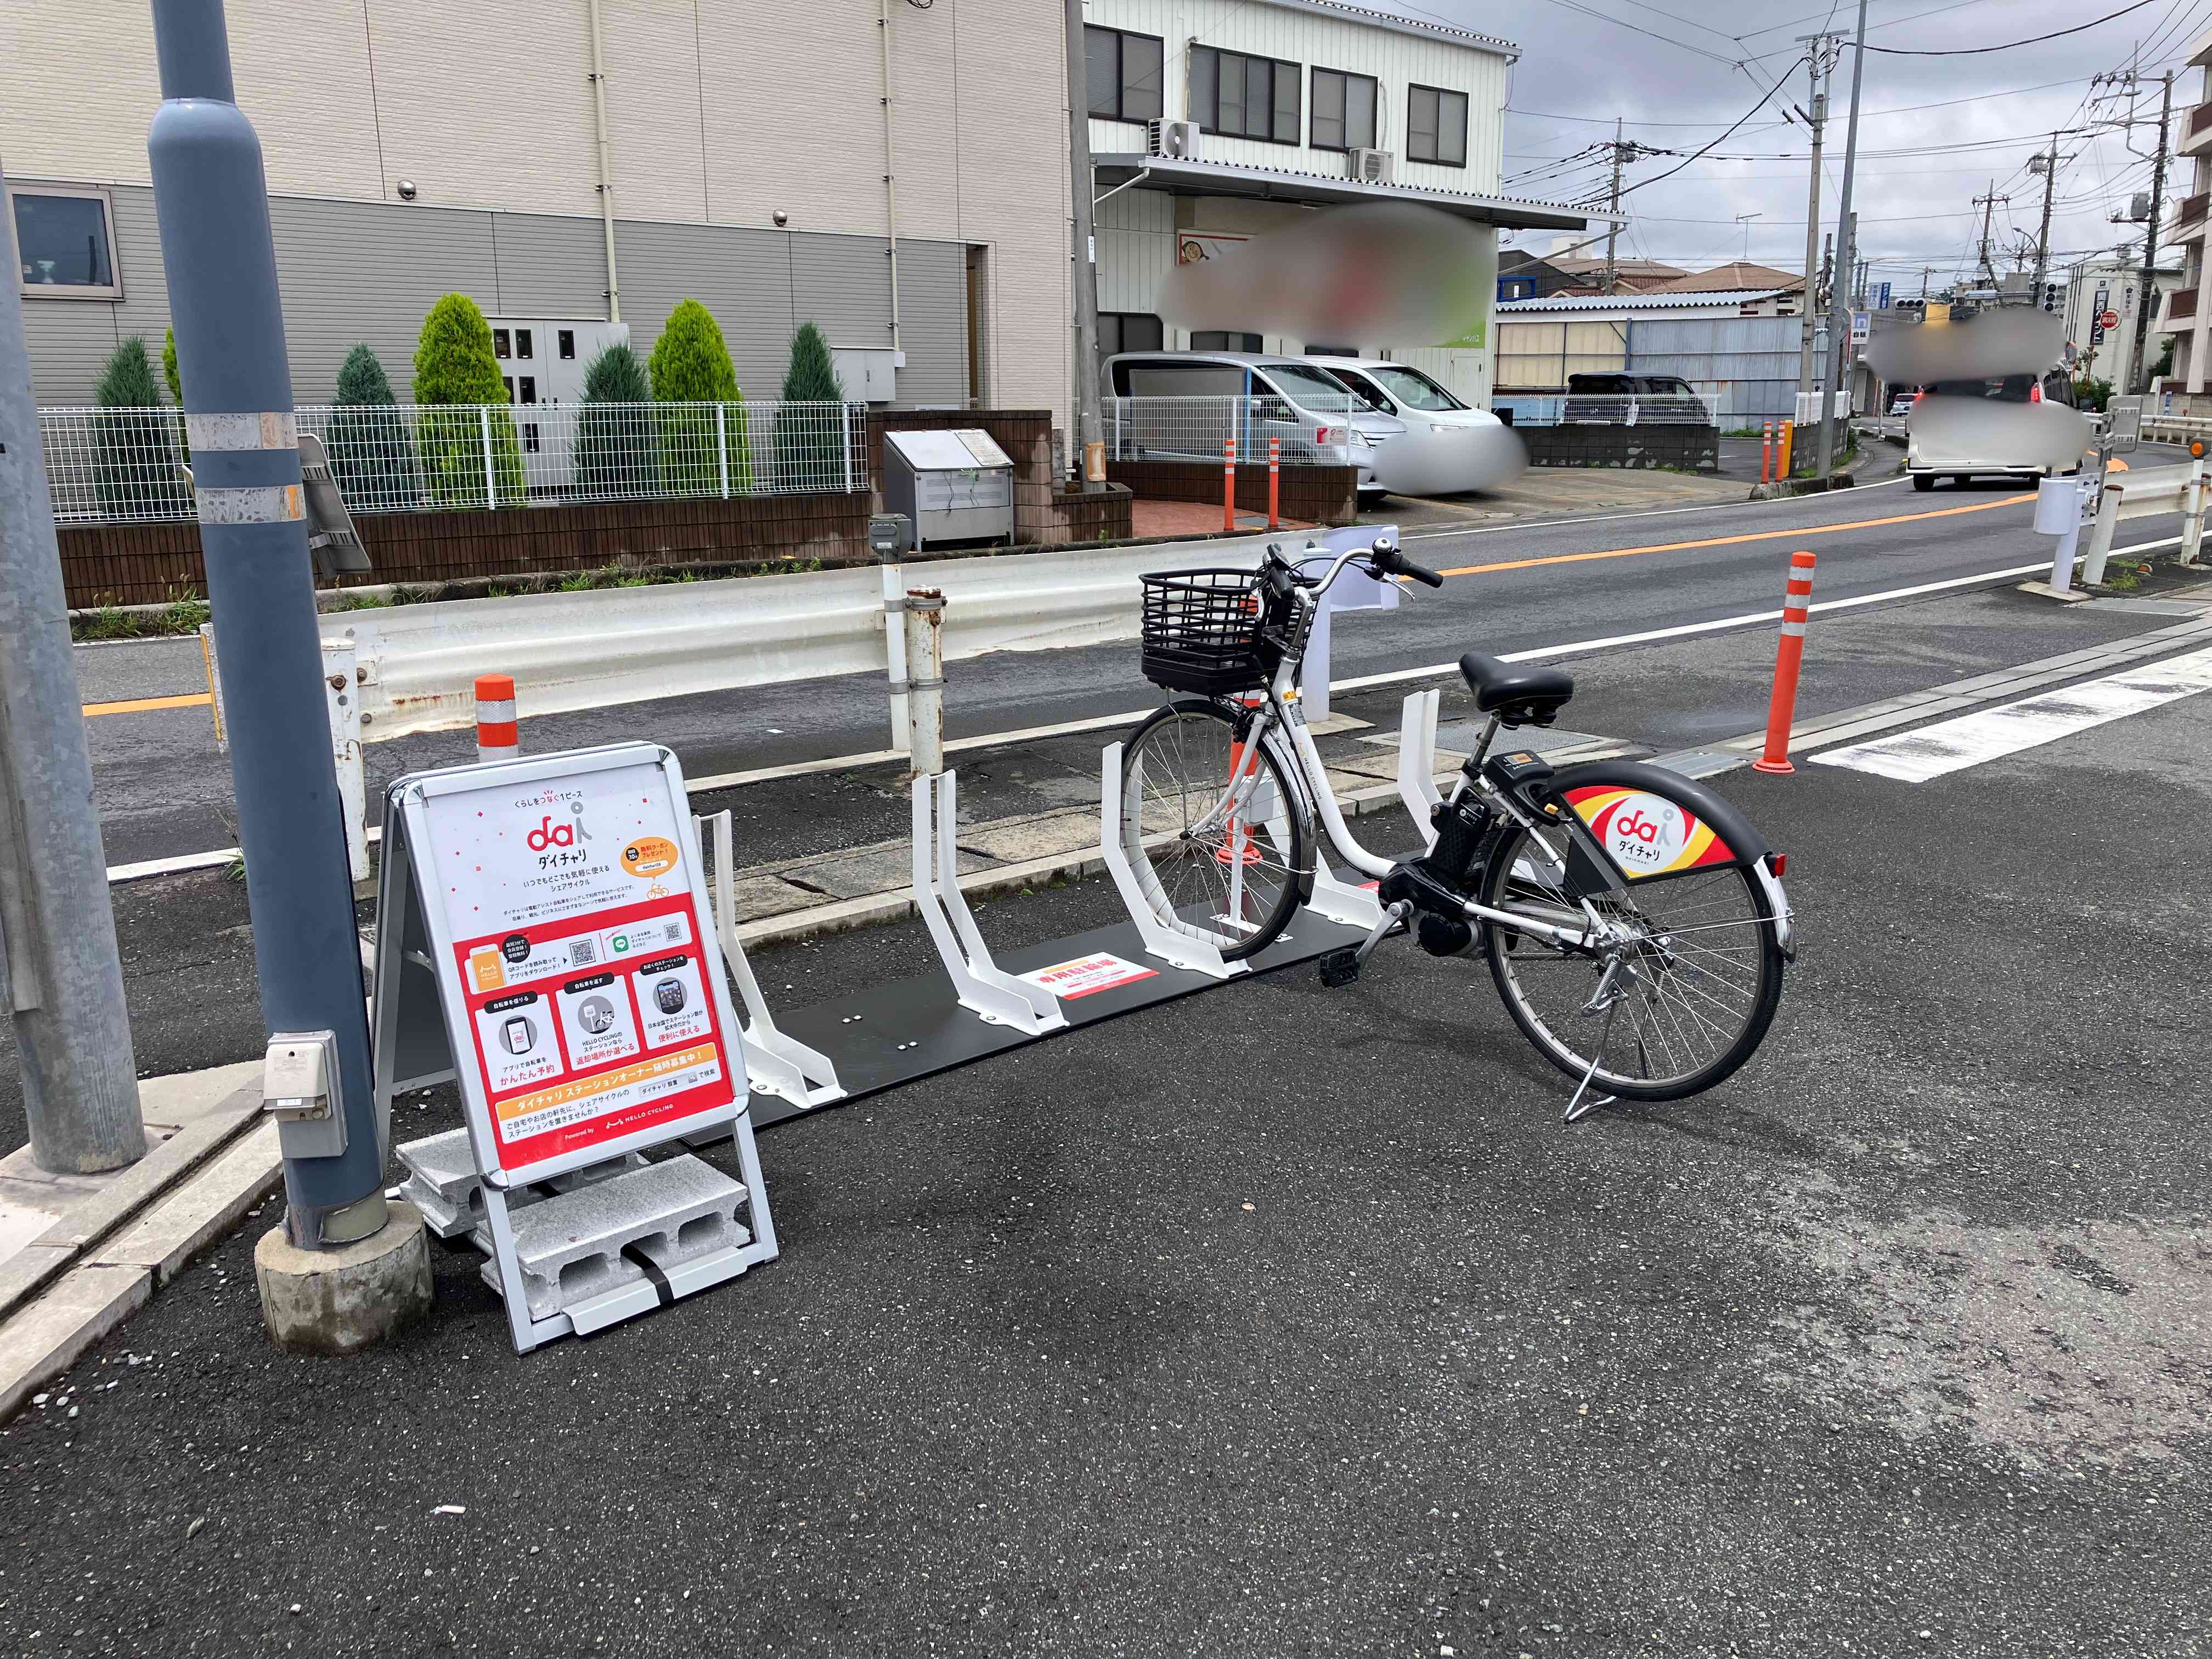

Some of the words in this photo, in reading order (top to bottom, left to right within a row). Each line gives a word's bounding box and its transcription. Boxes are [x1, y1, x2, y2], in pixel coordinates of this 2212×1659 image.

[1311, 777, 1322, 799] CYCLING
[527, 802, 592, 851] dai
[1617, 809, 1674, 847] dai
[1619, 840, 1660, 861] ダイチャリ
[539, 849, 586, 870] ダイチャリ
[523, 865, 610, 888] いつでもどこでも気軽に使える
[551, 879, 590, 892] シェアサイクル
[508, 957, 556, 972] QRコードを読み取って
[575, 977, 603, 990] 自転車を返す
[493, 996, 529, 1009] 自転車を借りる
[648, 1010, 703, 1029] 日本全国でステーション数が
[582, 1037, 597, 1046] HELLO
[658, 1025, 700, 1042] 便利に使える
[576, 1043, 635, 1065] 返却場所が選べる
[584, 1038, 622, 1053] ステーションなら
[503, 1057, 546, 1073] アプリで自転車を
[500, 1064, 555, 1086] かんたん予約
[698, 1069, 715, 1079] で検索
[642, 1083, 667, 1094] ダイチャリ
[517, 1090, 562, 1111] ダイチャリ
[625, 1112, 646, 1122] HELLO
[647, 1104, 674, 1115] CYCLING
[565, 1130, 587, 1140] Powered
